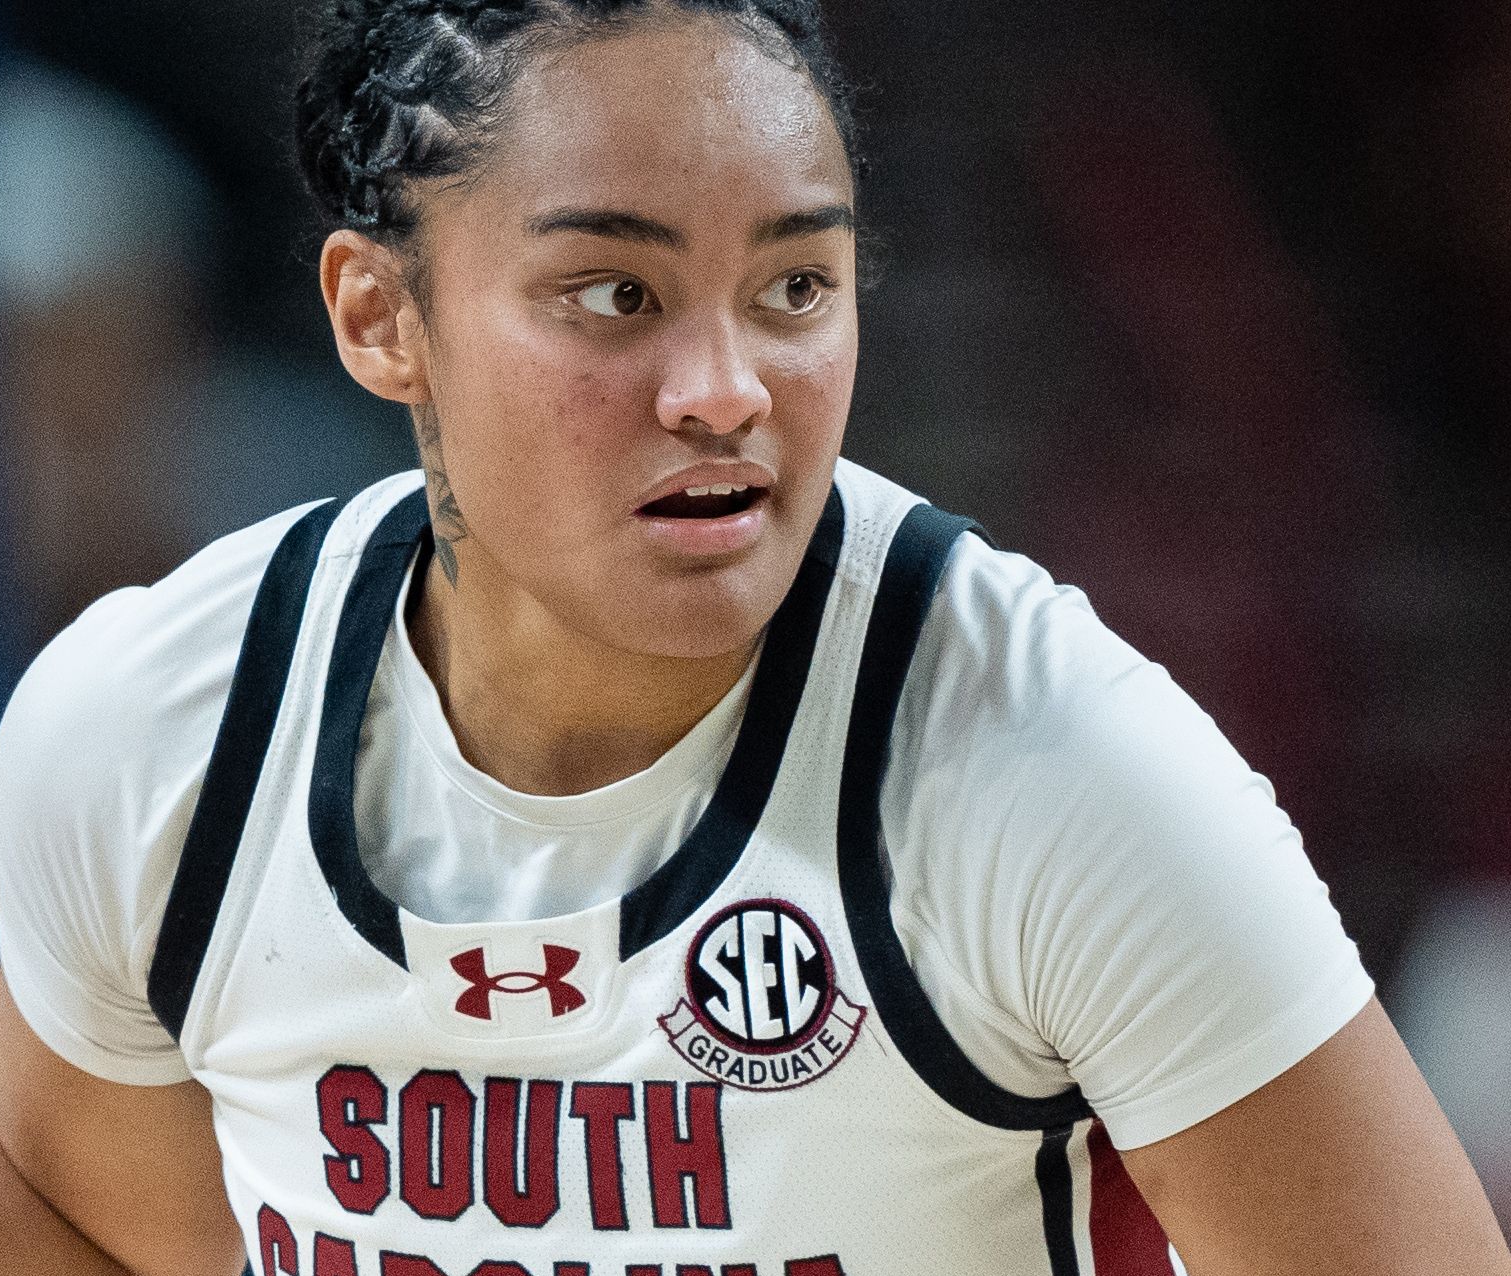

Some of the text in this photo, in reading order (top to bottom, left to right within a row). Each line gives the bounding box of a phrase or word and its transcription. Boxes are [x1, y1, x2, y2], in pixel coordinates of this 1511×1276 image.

[697, 910, 821, 1040] SEC
[687, 1028, 843, 1085] GRADUATE
[315, 1063, 732, 1231] SOUTH
